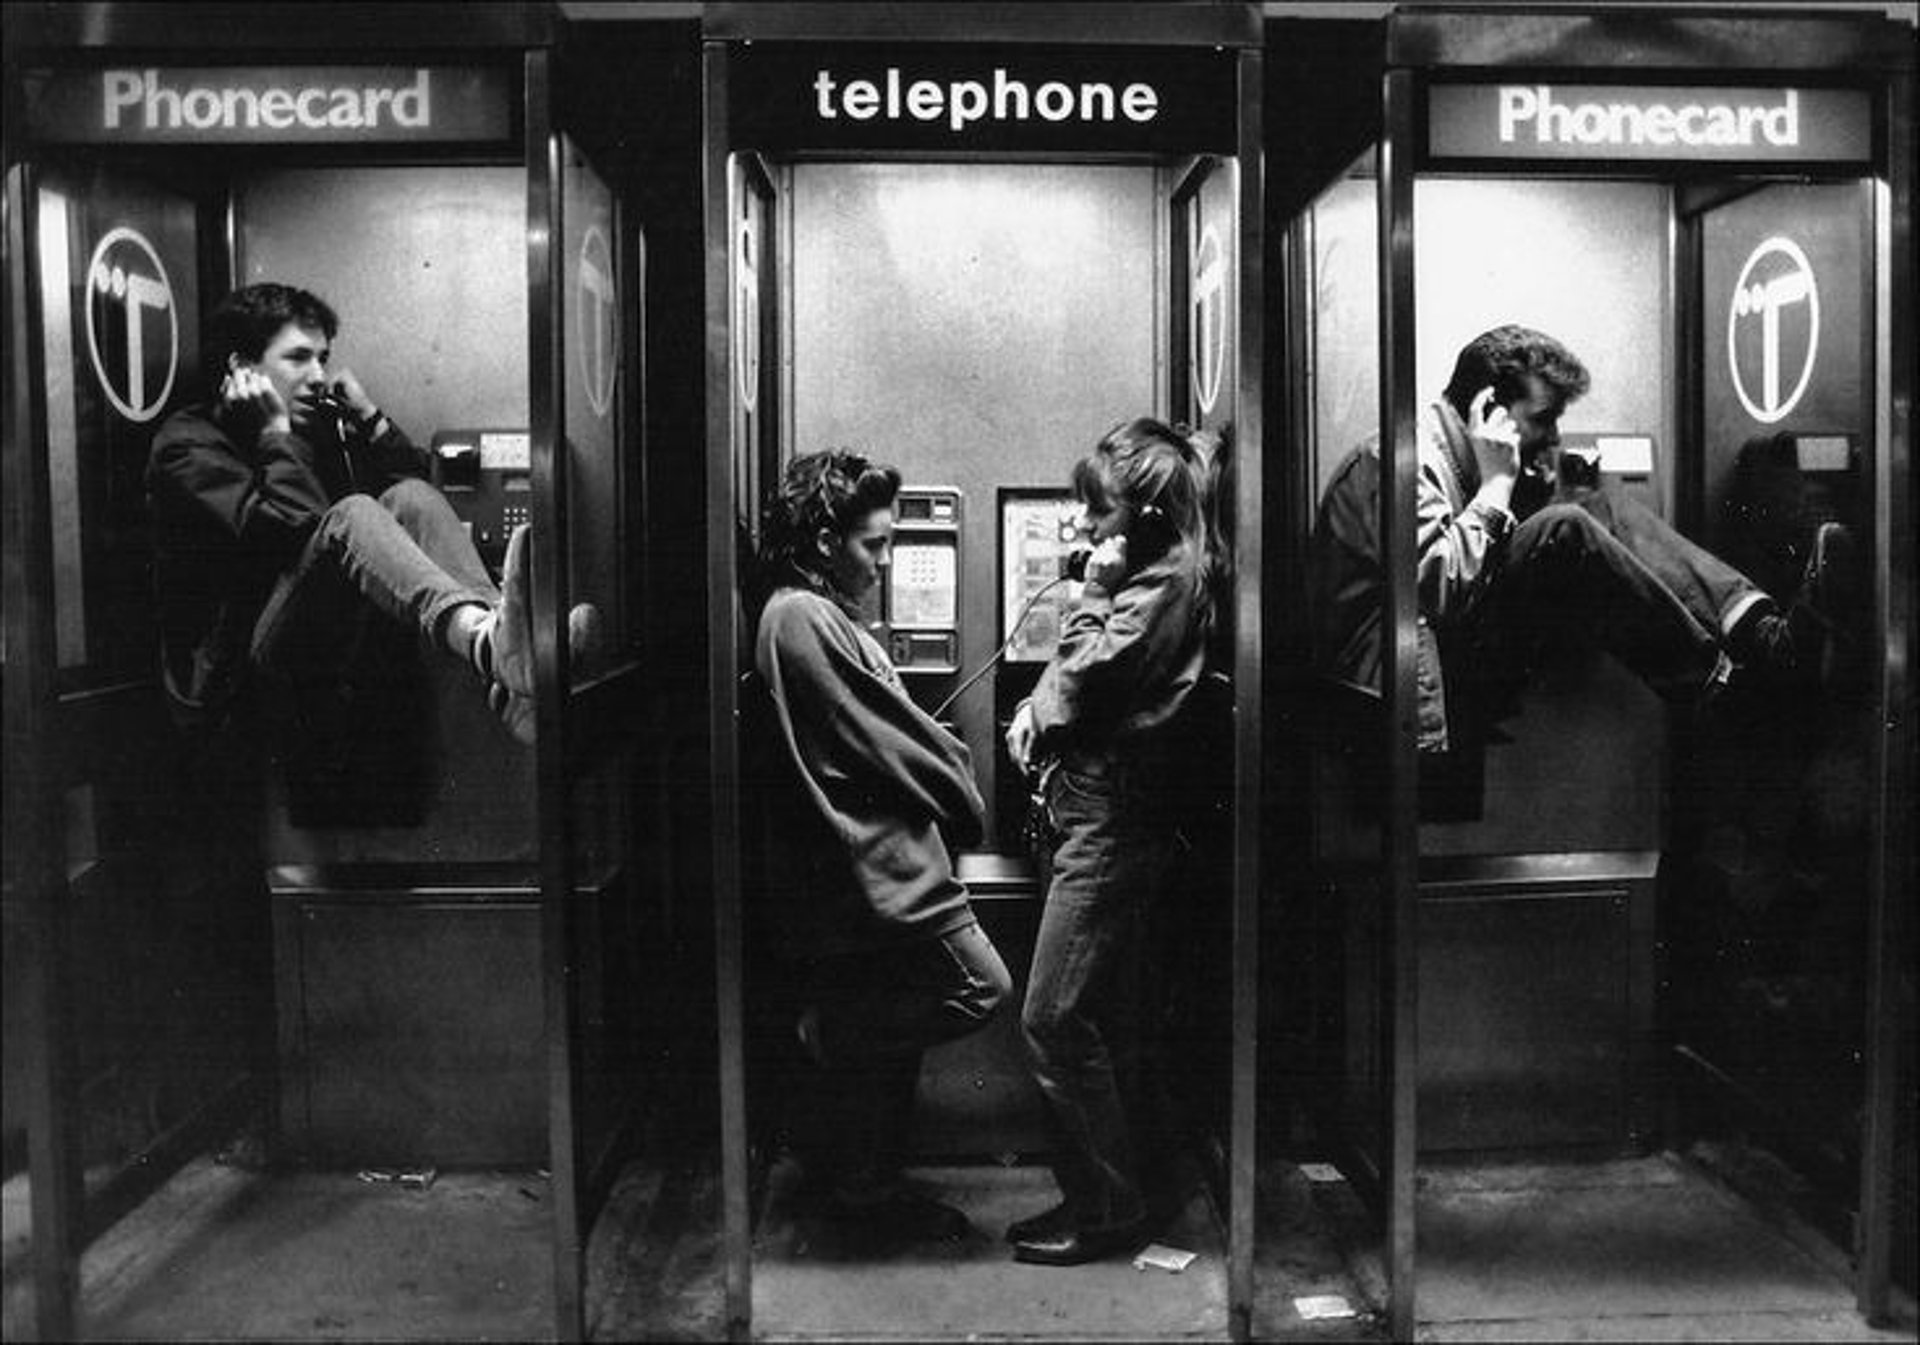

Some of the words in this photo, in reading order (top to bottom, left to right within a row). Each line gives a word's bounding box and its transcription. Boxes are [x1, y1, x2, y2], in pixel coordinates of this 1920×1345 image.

[104, 69, 430, 129] Phonecard
[814, 68, 1159, 131] telephone
[1500, 86, 1799, 145] Phonecard
